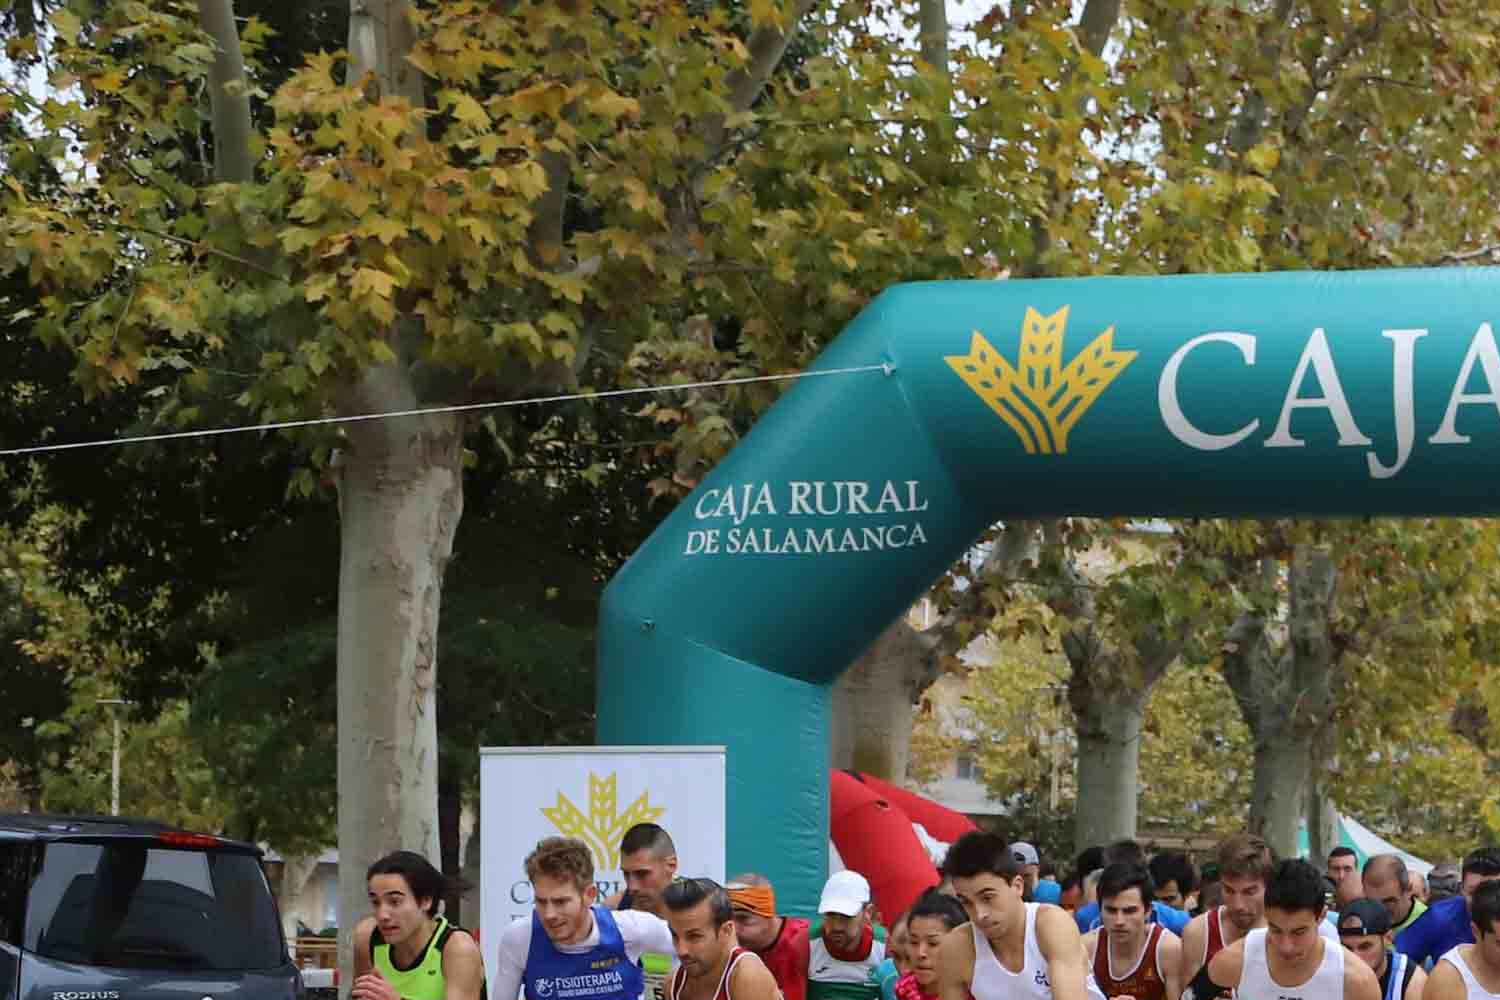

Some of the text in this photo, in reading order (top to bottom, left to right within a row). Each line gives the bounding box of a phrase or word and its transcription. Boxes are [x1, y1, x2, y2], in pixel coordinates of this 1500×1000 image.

[694, 479, 929, 526] CAJA RURAL
[683, 522, 928, 556] DE SALAMANCA
[555, 970, 623, 990] FISIOTERAPIA
